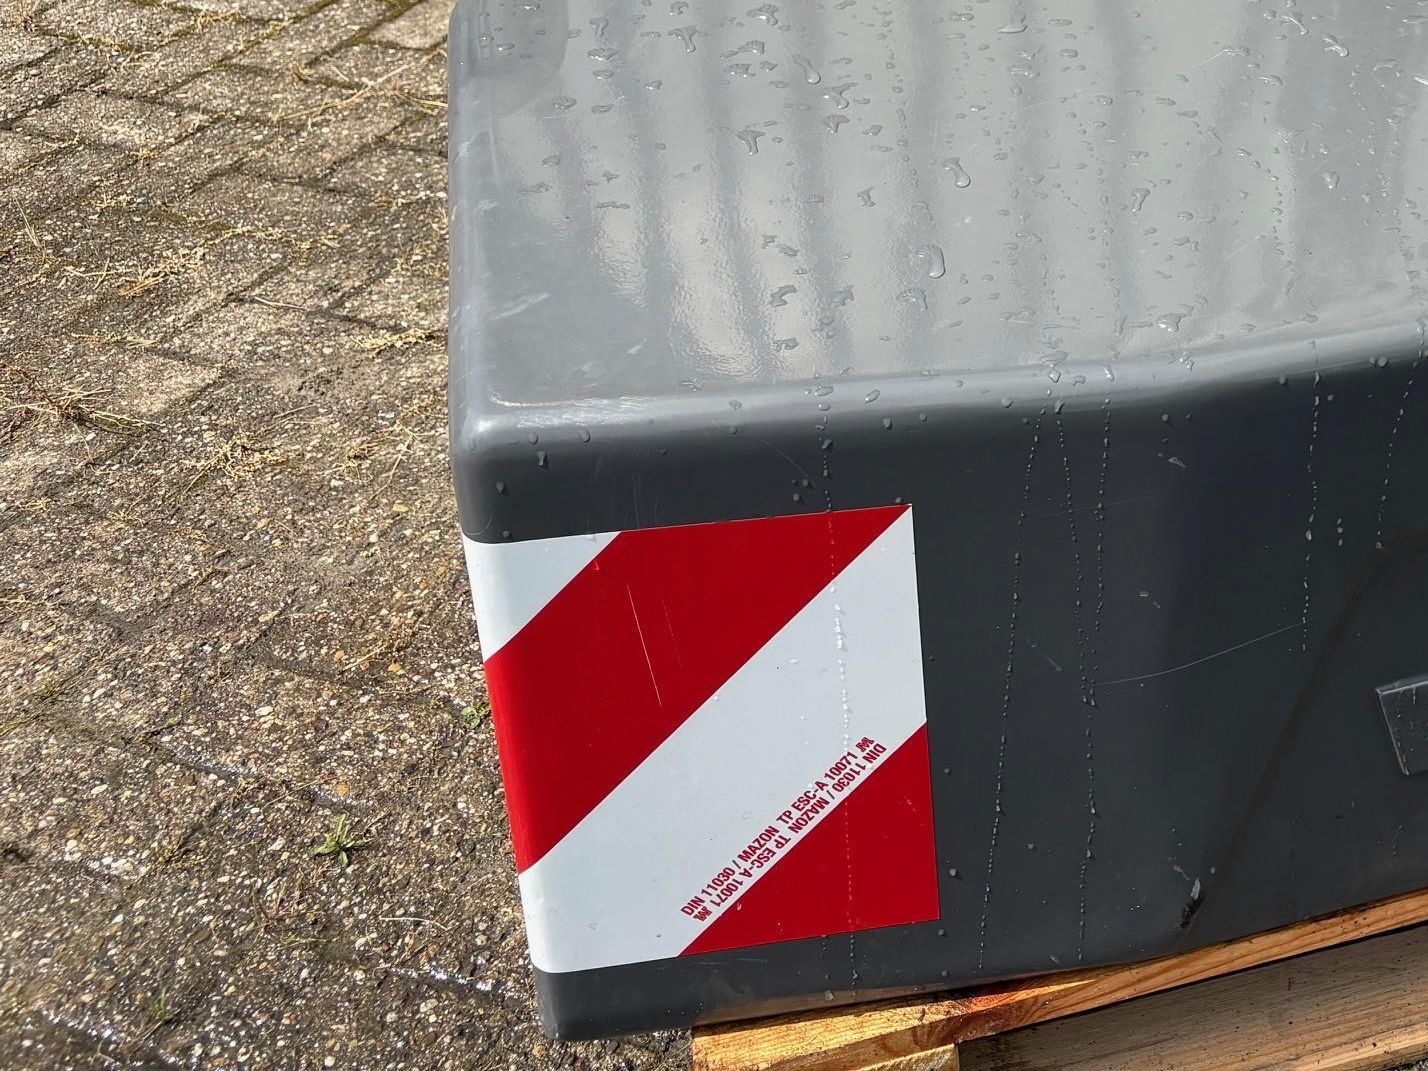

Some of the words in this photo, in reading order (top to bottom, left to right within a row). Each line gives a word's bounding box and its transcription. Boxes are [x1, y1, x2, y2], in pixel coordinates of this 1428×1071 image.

[862, 743, 887, 764] DIN
[831, 762, 867, 793] 11030
[787, 797, 830, 834] MAZON
[680, 895, 706, 916] DIN
[701, 867, 736, 897] 11030
[737, 826, 780, 863] MAZON
[776, 810, 794, 825] TP
[791, 781, 829, 812] ESC-A
[824, 751, 858, 781] 10071
[773, 835, 792, 850] TP
[738, 847, 777, 879] ESC-A
[709, 878, 744, 907] 10071
